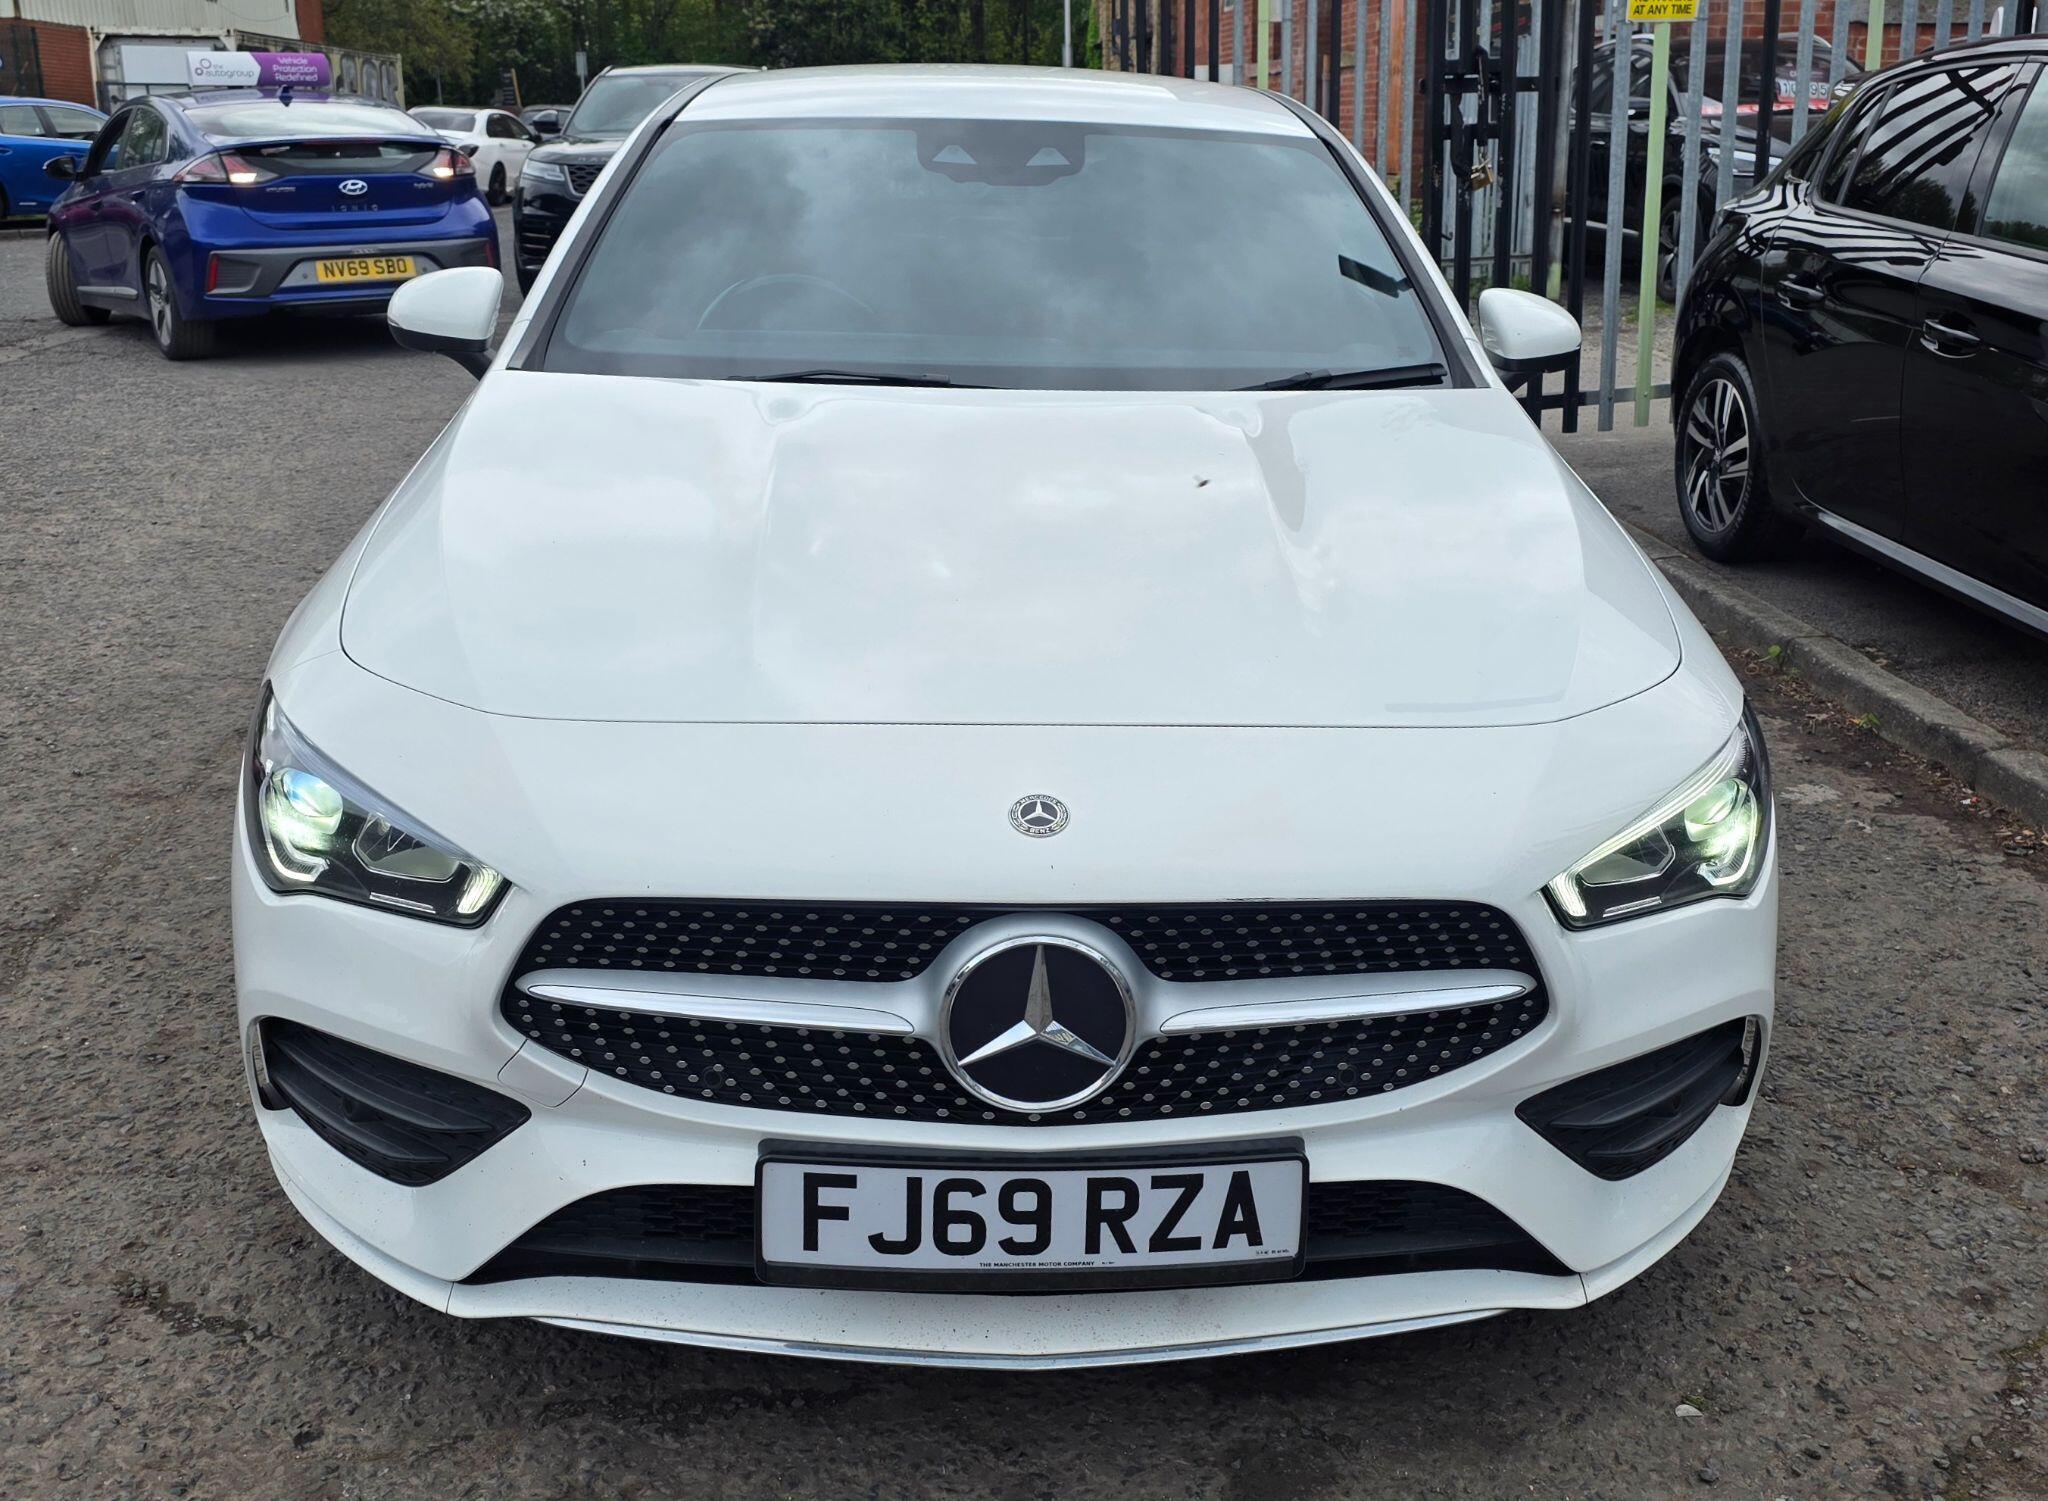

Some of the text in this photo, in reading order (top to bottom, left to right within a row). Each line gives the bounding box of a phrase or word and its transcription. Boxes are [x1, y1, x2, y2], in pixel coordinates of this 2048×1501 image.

[1633, 4, 1692, 15] AT ANY TIME
[272, 64, 318, 73] Protection
[205, 70, 255, 78] autogroup
[275, 73, 318, 81] Redefined
[323, 258, 408, 279] NV69 SBO
[802, 1170, 1264, 1255] FJ69 RZA
